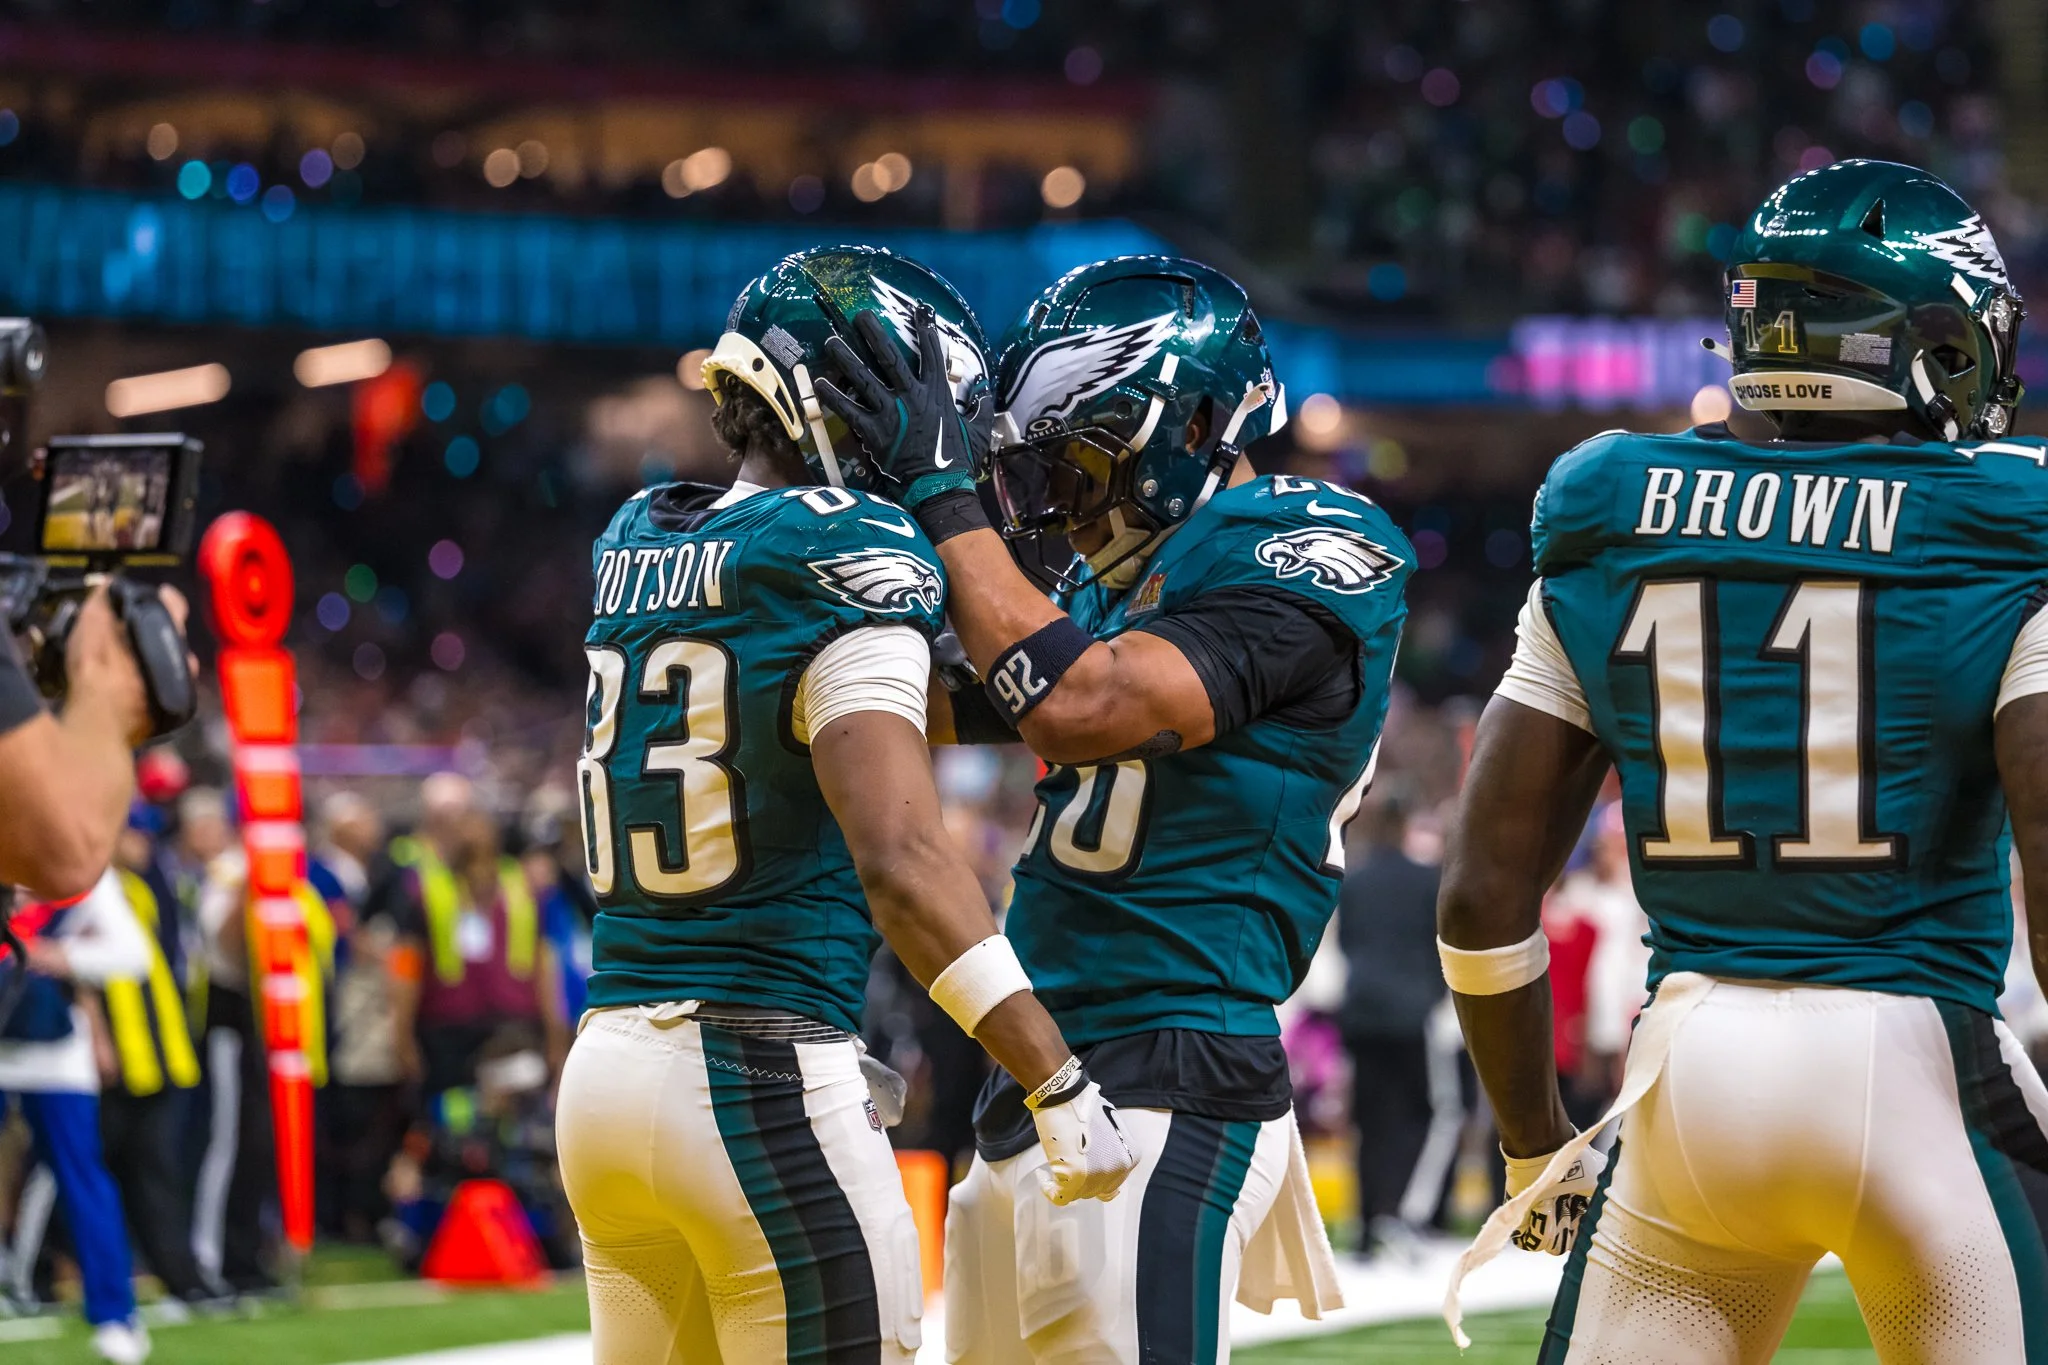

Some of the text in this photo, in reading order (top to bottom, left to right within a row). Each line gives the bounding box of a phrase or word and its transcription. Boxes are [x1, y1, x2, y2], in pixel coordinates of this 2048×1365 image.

[1741, 309, 1799, 354] 11
[1735, 384, 1832, 400] CHOOSE LOVE
[1634, 466, 1908, 554] BROWN
[993, 648, 1048, 714] 92
[1610, 576, 1909, 870] 11
[577, 638, 750, 896] 83
[1034, 1059, 1078, 1102] LEGENDARY
